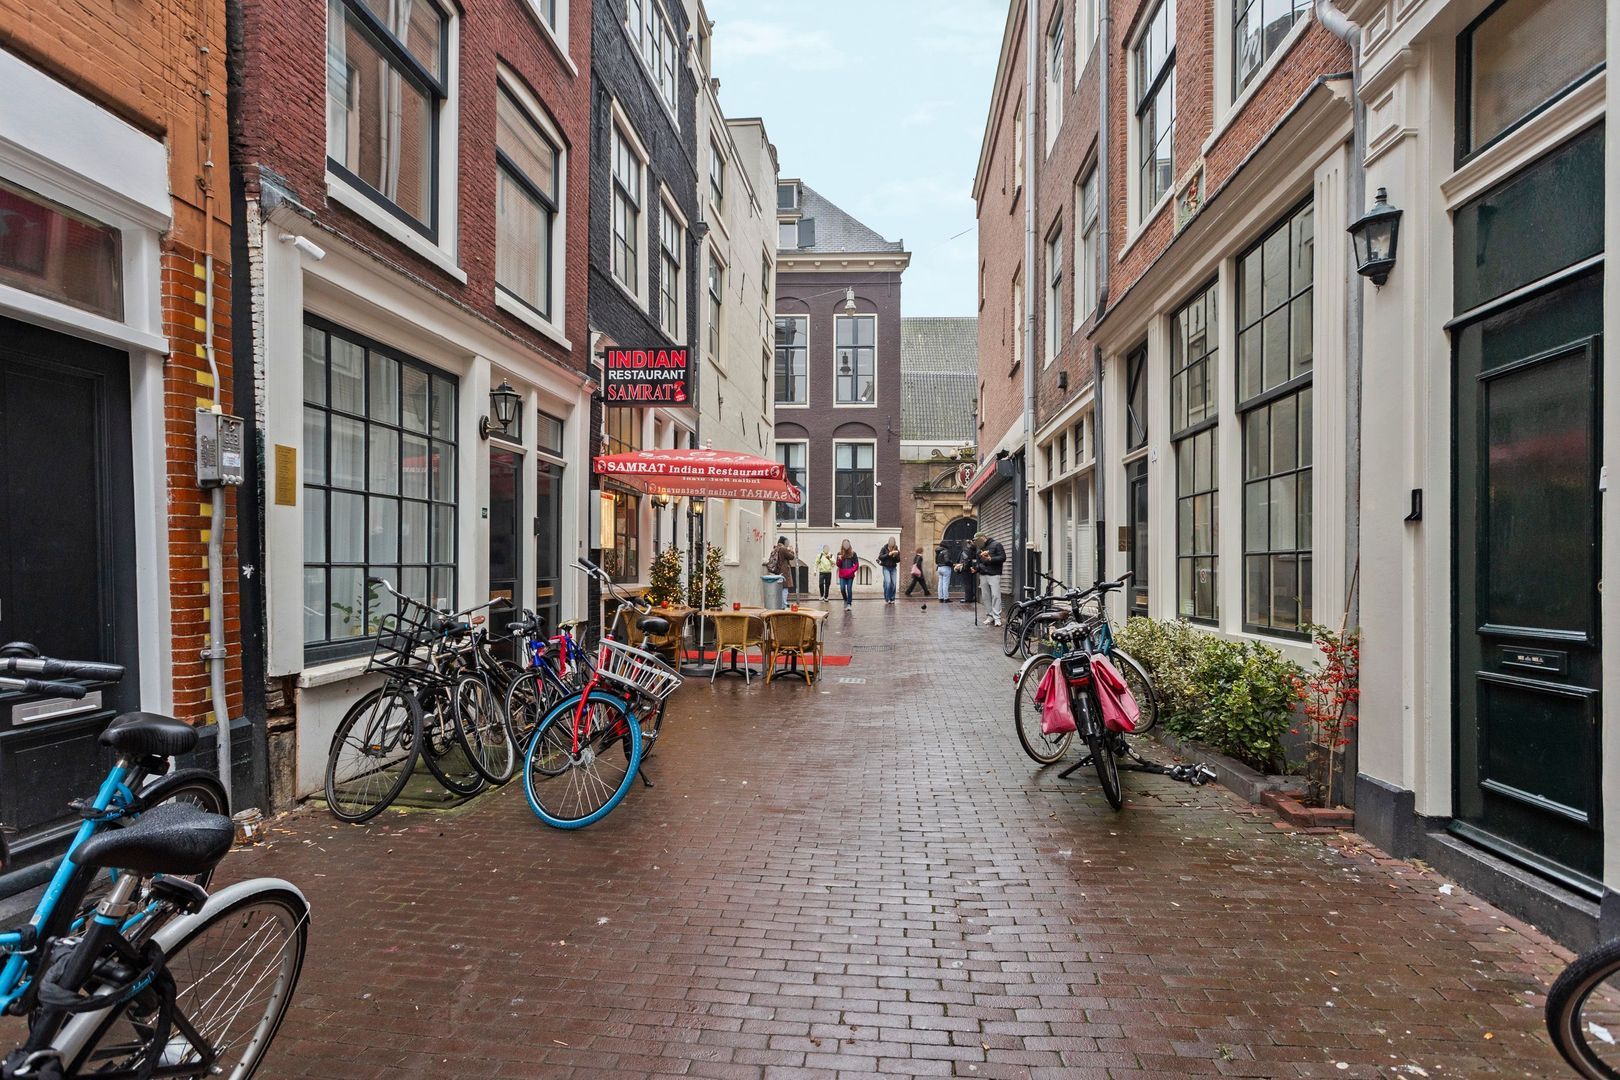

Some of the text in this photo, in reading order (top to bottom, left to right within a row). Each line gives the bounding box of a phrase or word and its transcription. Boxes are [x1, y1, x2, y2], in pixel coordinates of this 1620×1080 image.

[608, 350, 687, 368] INDIAN
[608, 369, 686, 380] RESTAURANT
[608, 383, 674, 401] SAMRAT
[607, 461, 769, 476] SAMRAT Indian Restaurant
